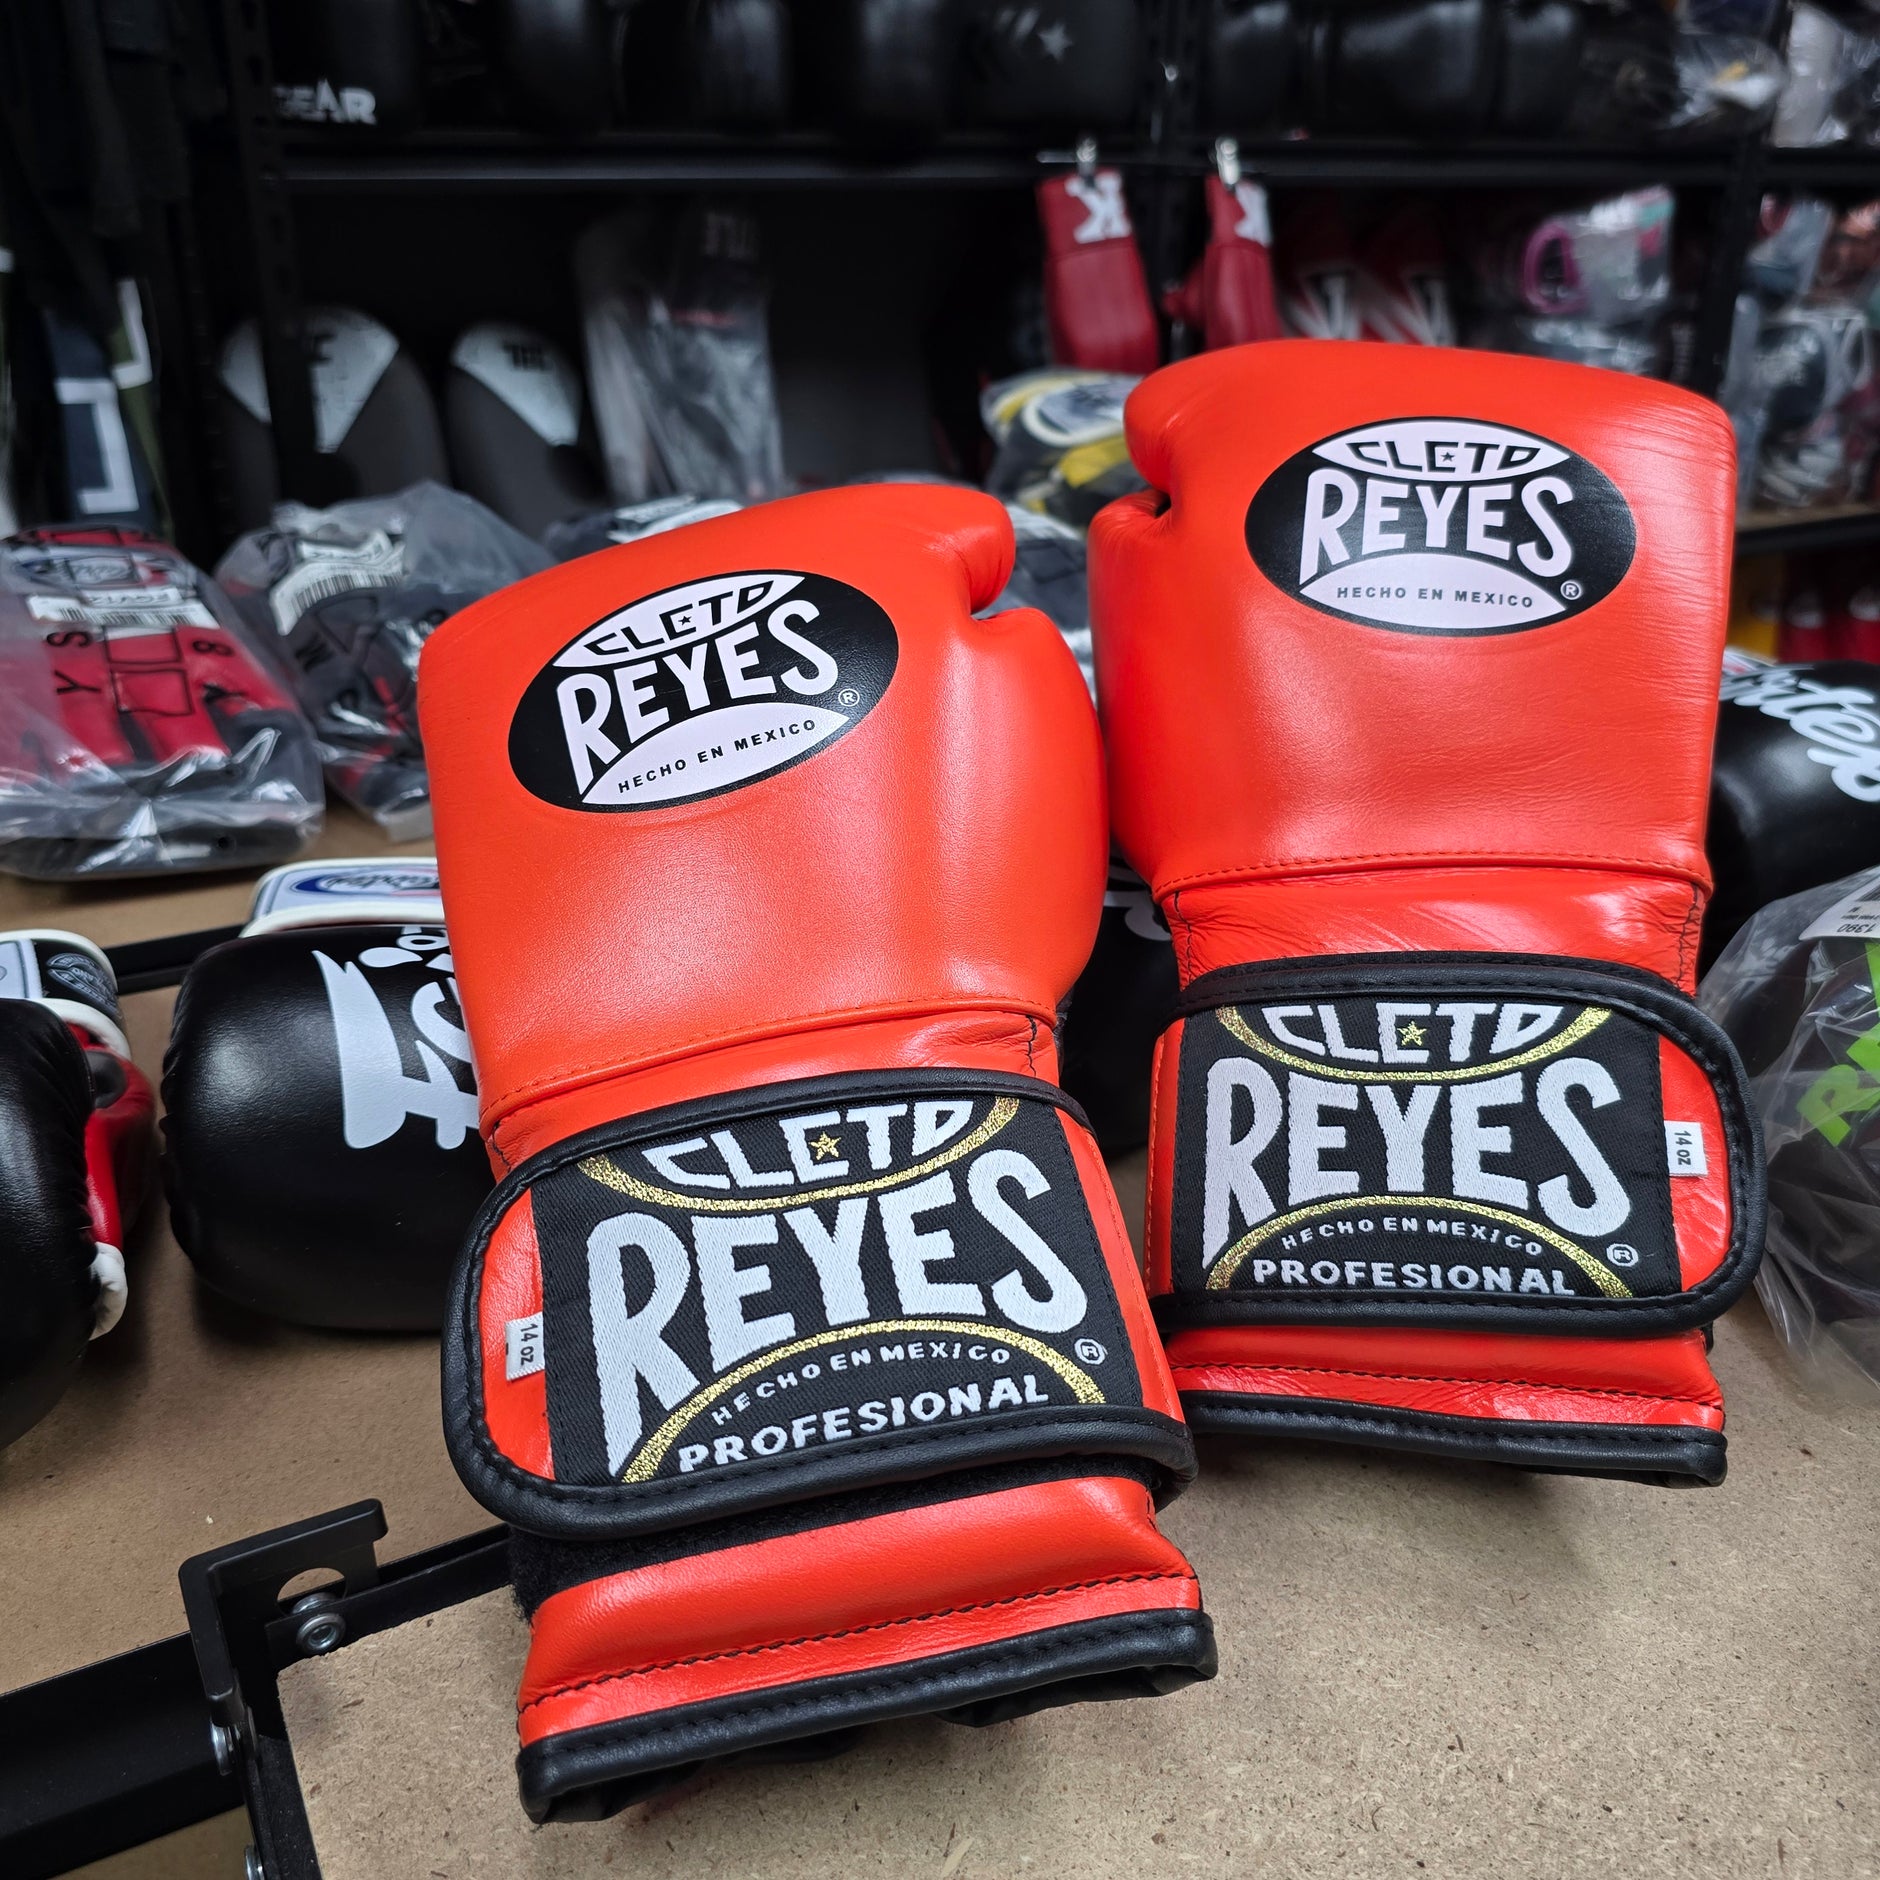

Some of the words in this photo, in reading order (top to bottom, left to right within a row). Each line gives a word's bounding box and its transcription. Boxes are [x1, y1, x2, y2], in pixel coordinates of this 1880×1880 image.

[1346, 440, 1541, 473] CLETO
[1299, 468, 1573, 585] REYES
[583, 580, 775, 656] CLETO
[1337, 586, 1406, 600] HECHO
[1418, 587, 1443, 601] EN
[1455, 589, 1533, 609] MEXICO
[557, 600, 839, 795] REYES
[618, 757, 687, 794] HECHO
[697, 745, 724, 764] EN
[735, 718, 817, 752] MEXICO
[1262, 1002, 1564, 1064] CLETO
[642, 1101, 974, 1190] CLETO
[1202, 1057, 1631, 1269] REYES
[1674, 1131, 1693, 1146] 14
[1281, 1218, 1374, 1250] HECHO
[1382, 1217, 1418, 1232] EN
[1426, 1218, 1542, 1256] MEXICO
[586, 1149, 1088, 1477] REYES
[1253, 1259, 1576, 1296] PROFESIONAL
[521, 1323, 539, 1342] 14
[711, 1362, 821, 1427] HECHO
[830, 1353, 871, 1372] EN
[879, 1340, 1011, 1364] MEXICO
[678, 1374, 1049, 1474] PROFESIONAL
